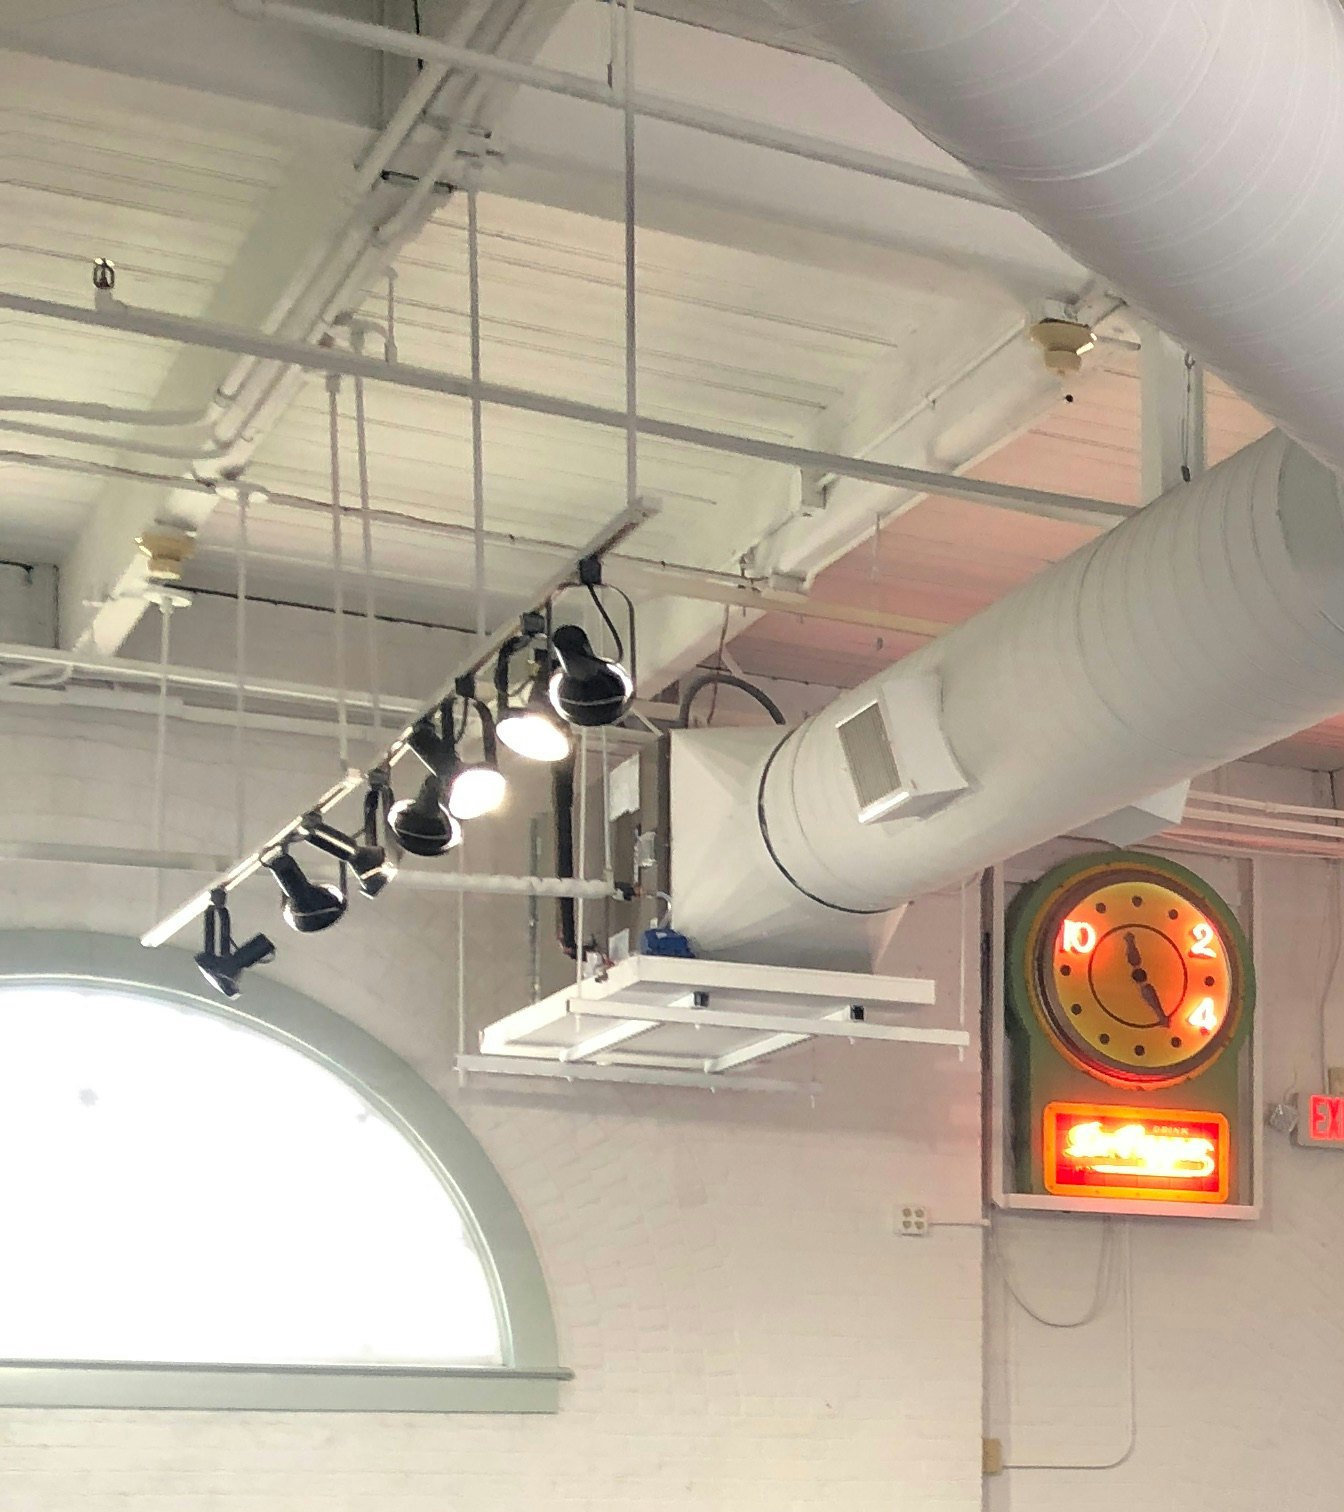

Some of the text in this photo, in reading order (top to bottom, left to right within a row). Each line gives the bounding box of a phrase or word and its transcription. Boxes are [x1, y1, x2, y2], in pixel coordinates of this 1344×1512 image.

[1060, 920, 1217, 957] 10 2
[1187, 997, 1217, 1032] 4
